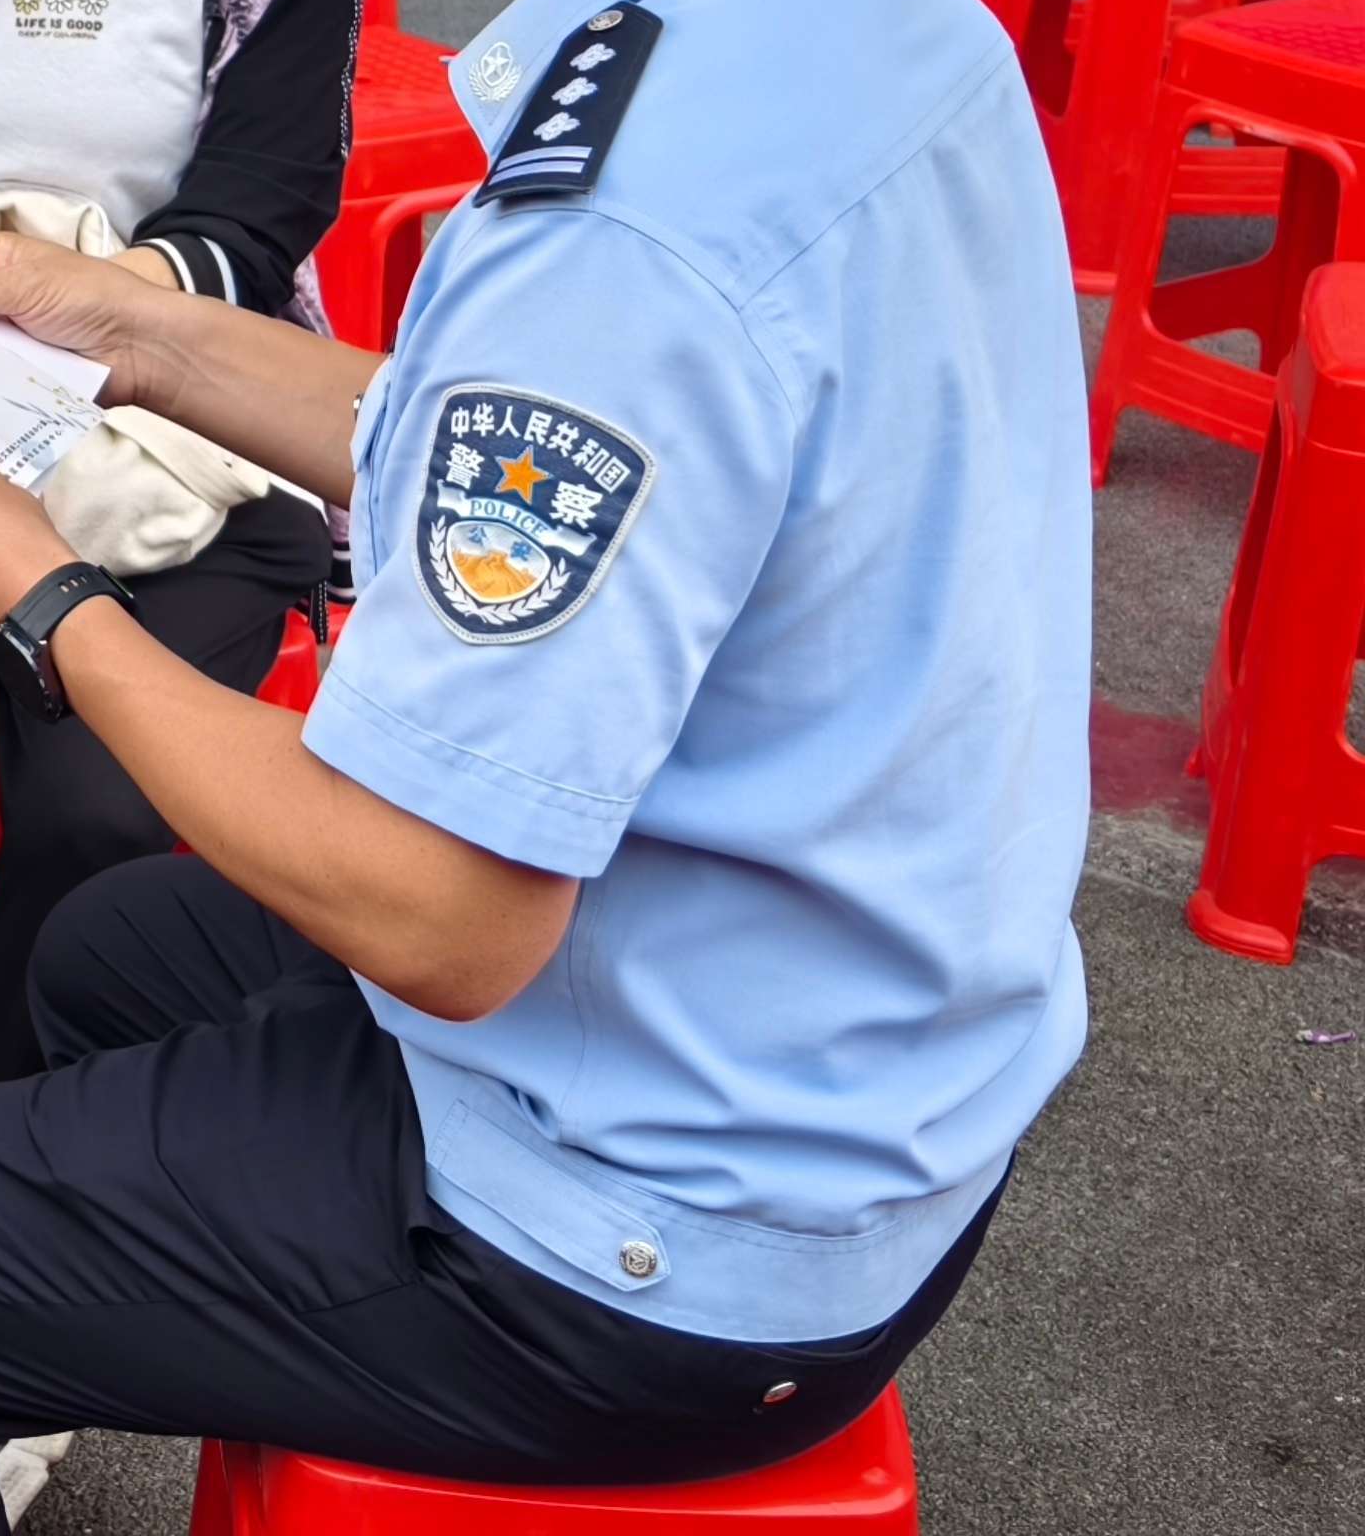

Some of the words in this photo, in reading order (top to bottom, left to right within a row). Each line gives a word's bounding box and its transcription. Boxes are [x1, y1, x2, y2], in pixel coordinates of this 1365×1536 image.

[15, 17, 46, 29] LIFE
[50, 18, 62, 29] IS
[67, 18, 103, 31] GOOD
[450, 402, 632, 494] 中华人民共和国
[446, 442, 486, 490] 警
[549, 480, 604, 529] 察
[470, 499, 549, 538] POLICE
